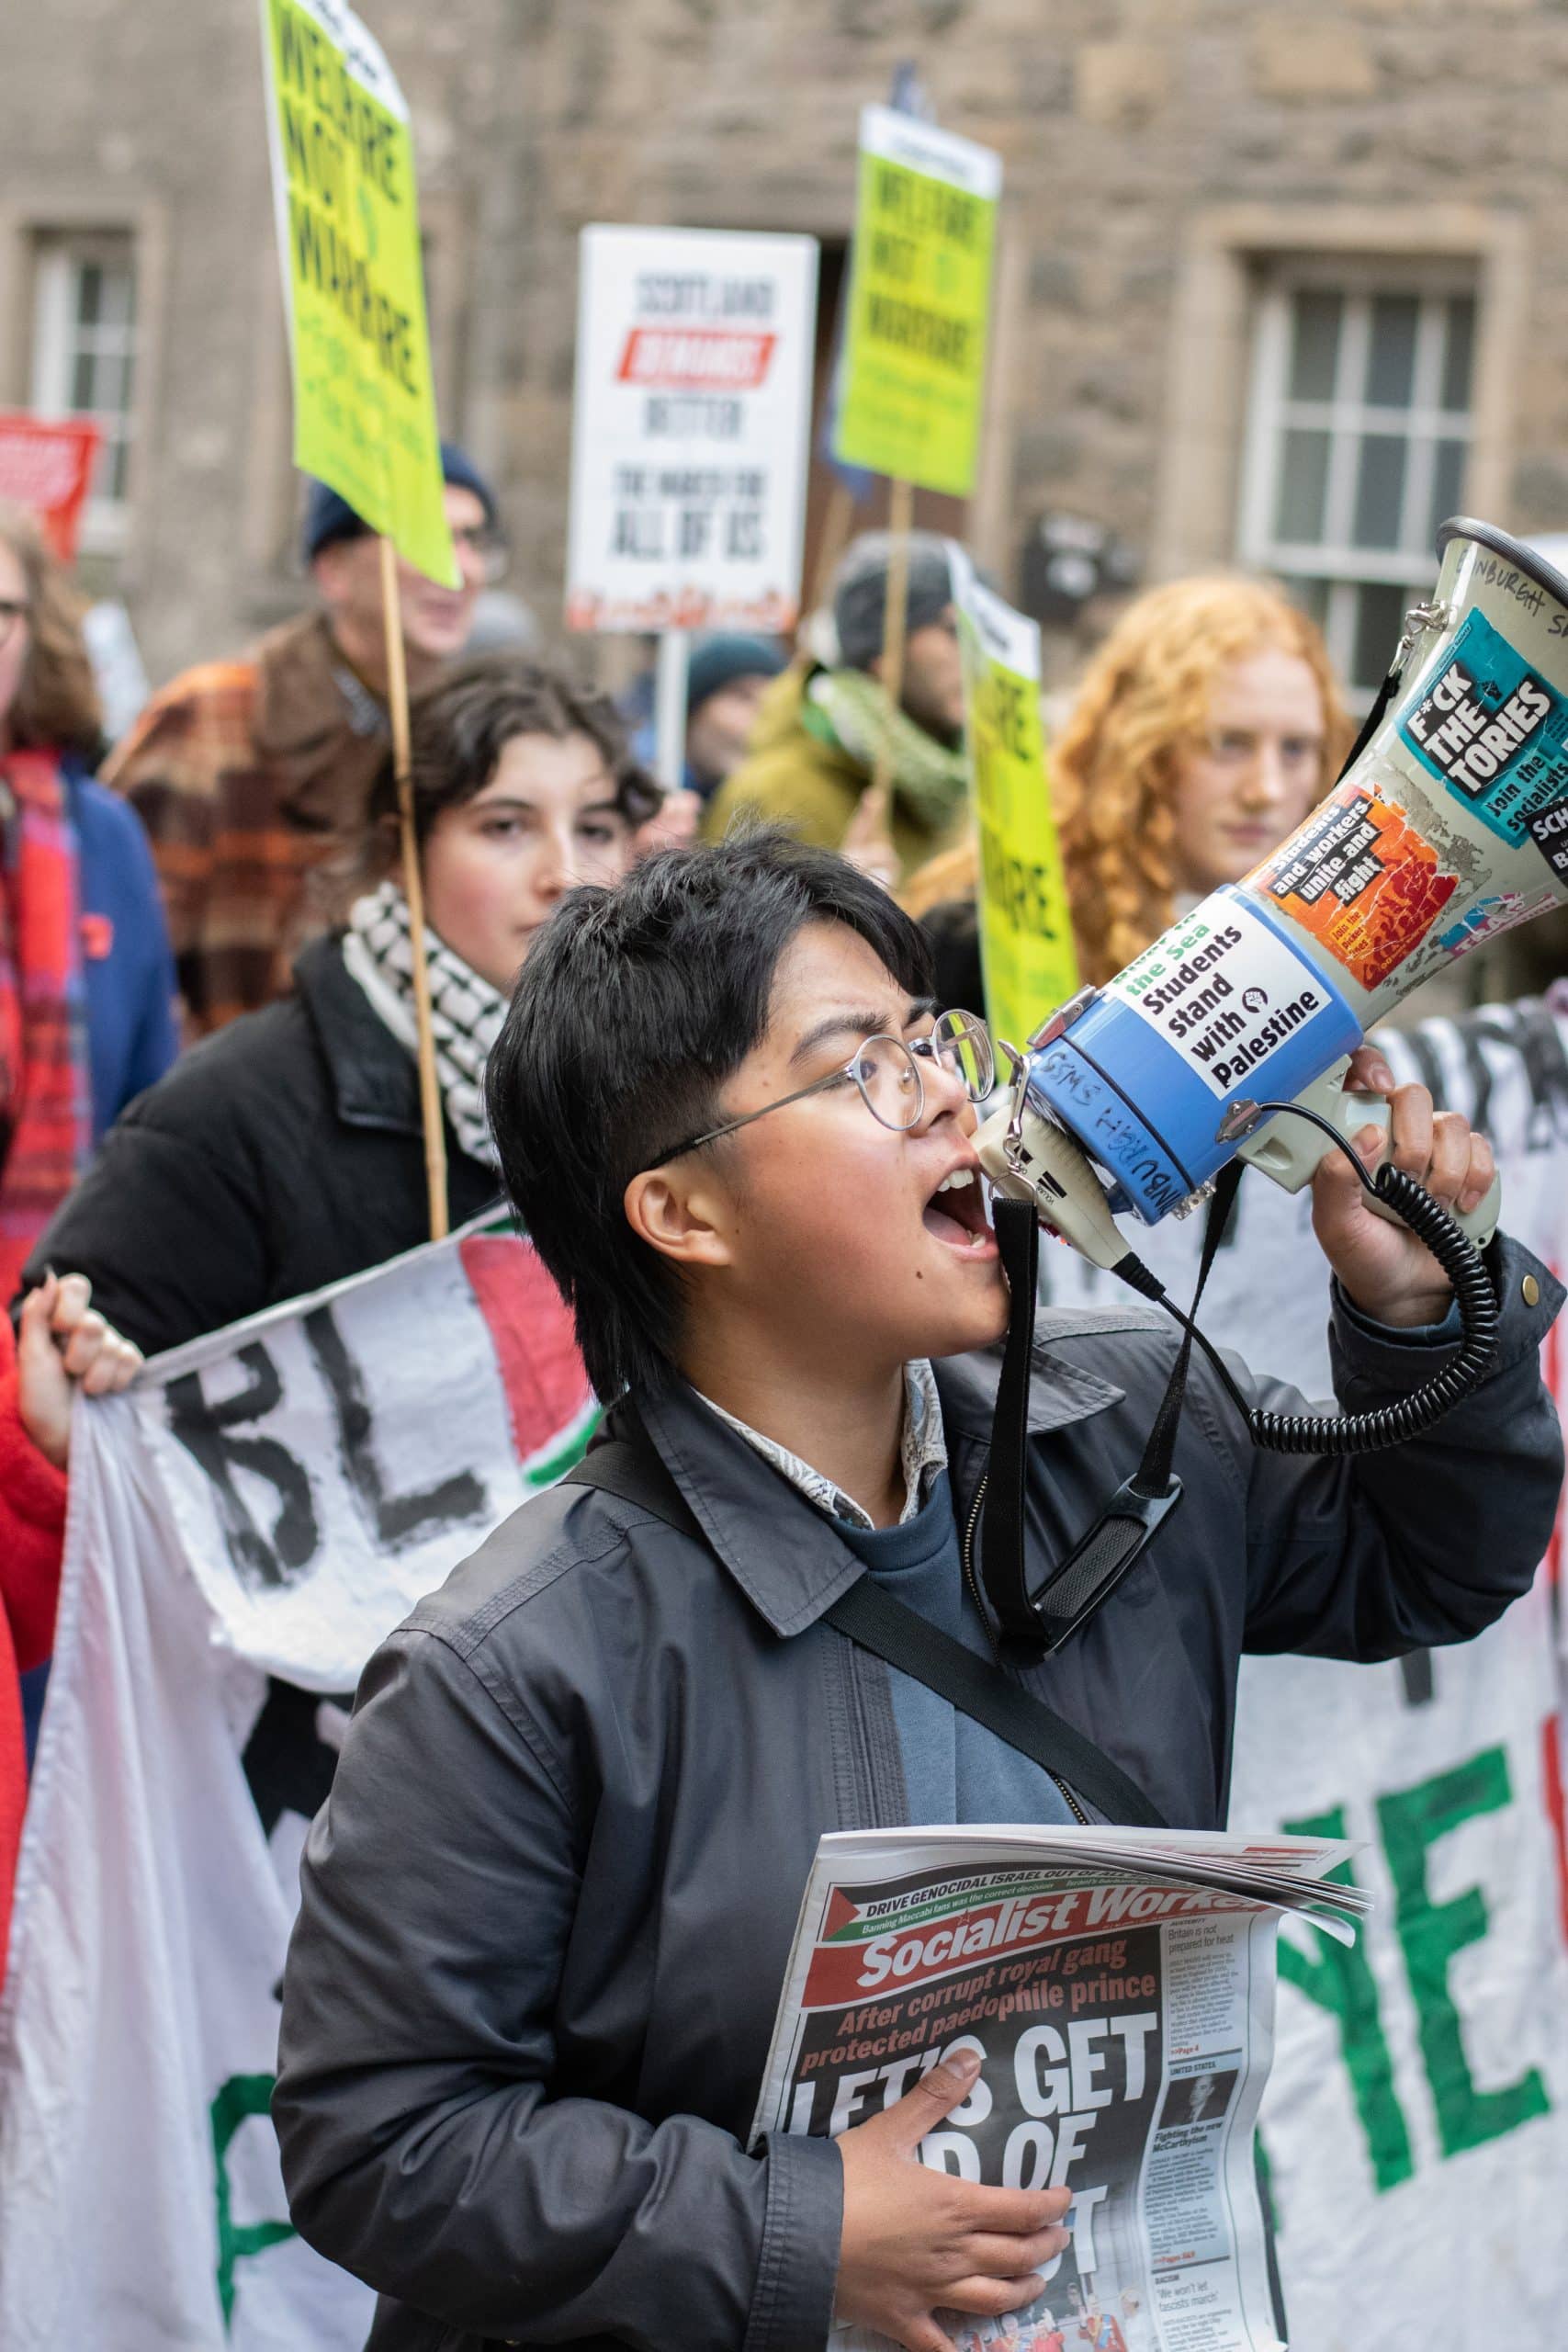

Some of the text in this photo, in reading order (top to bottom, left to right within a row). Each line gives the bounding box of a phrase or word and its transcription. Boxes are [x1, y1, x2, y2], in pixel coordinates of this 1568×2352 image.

[1424, 698, 1487, 765] THE
[1448, 681, 1551, 793] TORIES
[1517, 755, 1546, 783] the
[1273, 800, 1369, 895] and workers
[1300, 821, 1380, 900] unite and
[1334, 856, 1382, 901] fight
[1125, 923, 1211, 997] the Sea
[1143, 925, 1243, 1016] Students
[1190, 1011, 1247, 1062] with
[1211, 991, 1320, 1090] Palestine
[862, 1918, 897, 1935] Banning
[897, 1907, 933, 1926] Maccabi
[933, 1902, 952, 1916] fans
[952, 1898, 968, 1909] was
[969, 1893, 984, 1905] the
[866, 1894, 911, 1918] DRIVE
[910, 1875, 988, 1905] GENOCIDAL
[988, 1871, 1044, 1886] ISRAEL
[1044, 1869, 1075, 1879] OUT
[1203, 1924, 1217, 1934] not
[856, 1889, 1082, 1987] Socialist
[1204, 1937, 1215, 1948] for
[800, 2022, 929, 2076] protected
[930, 1980, 1064, 2045] paedophile
[1070, 1973, 1156, 2012] prince
[837, 1939, 1127, 2038] After corrupt royal gang
[1013, 2012, 1159, 2119] GET
[1002, 2112, 1099, 2192] OF
[1155, 2122, 1223, 2143] Fighting the new
